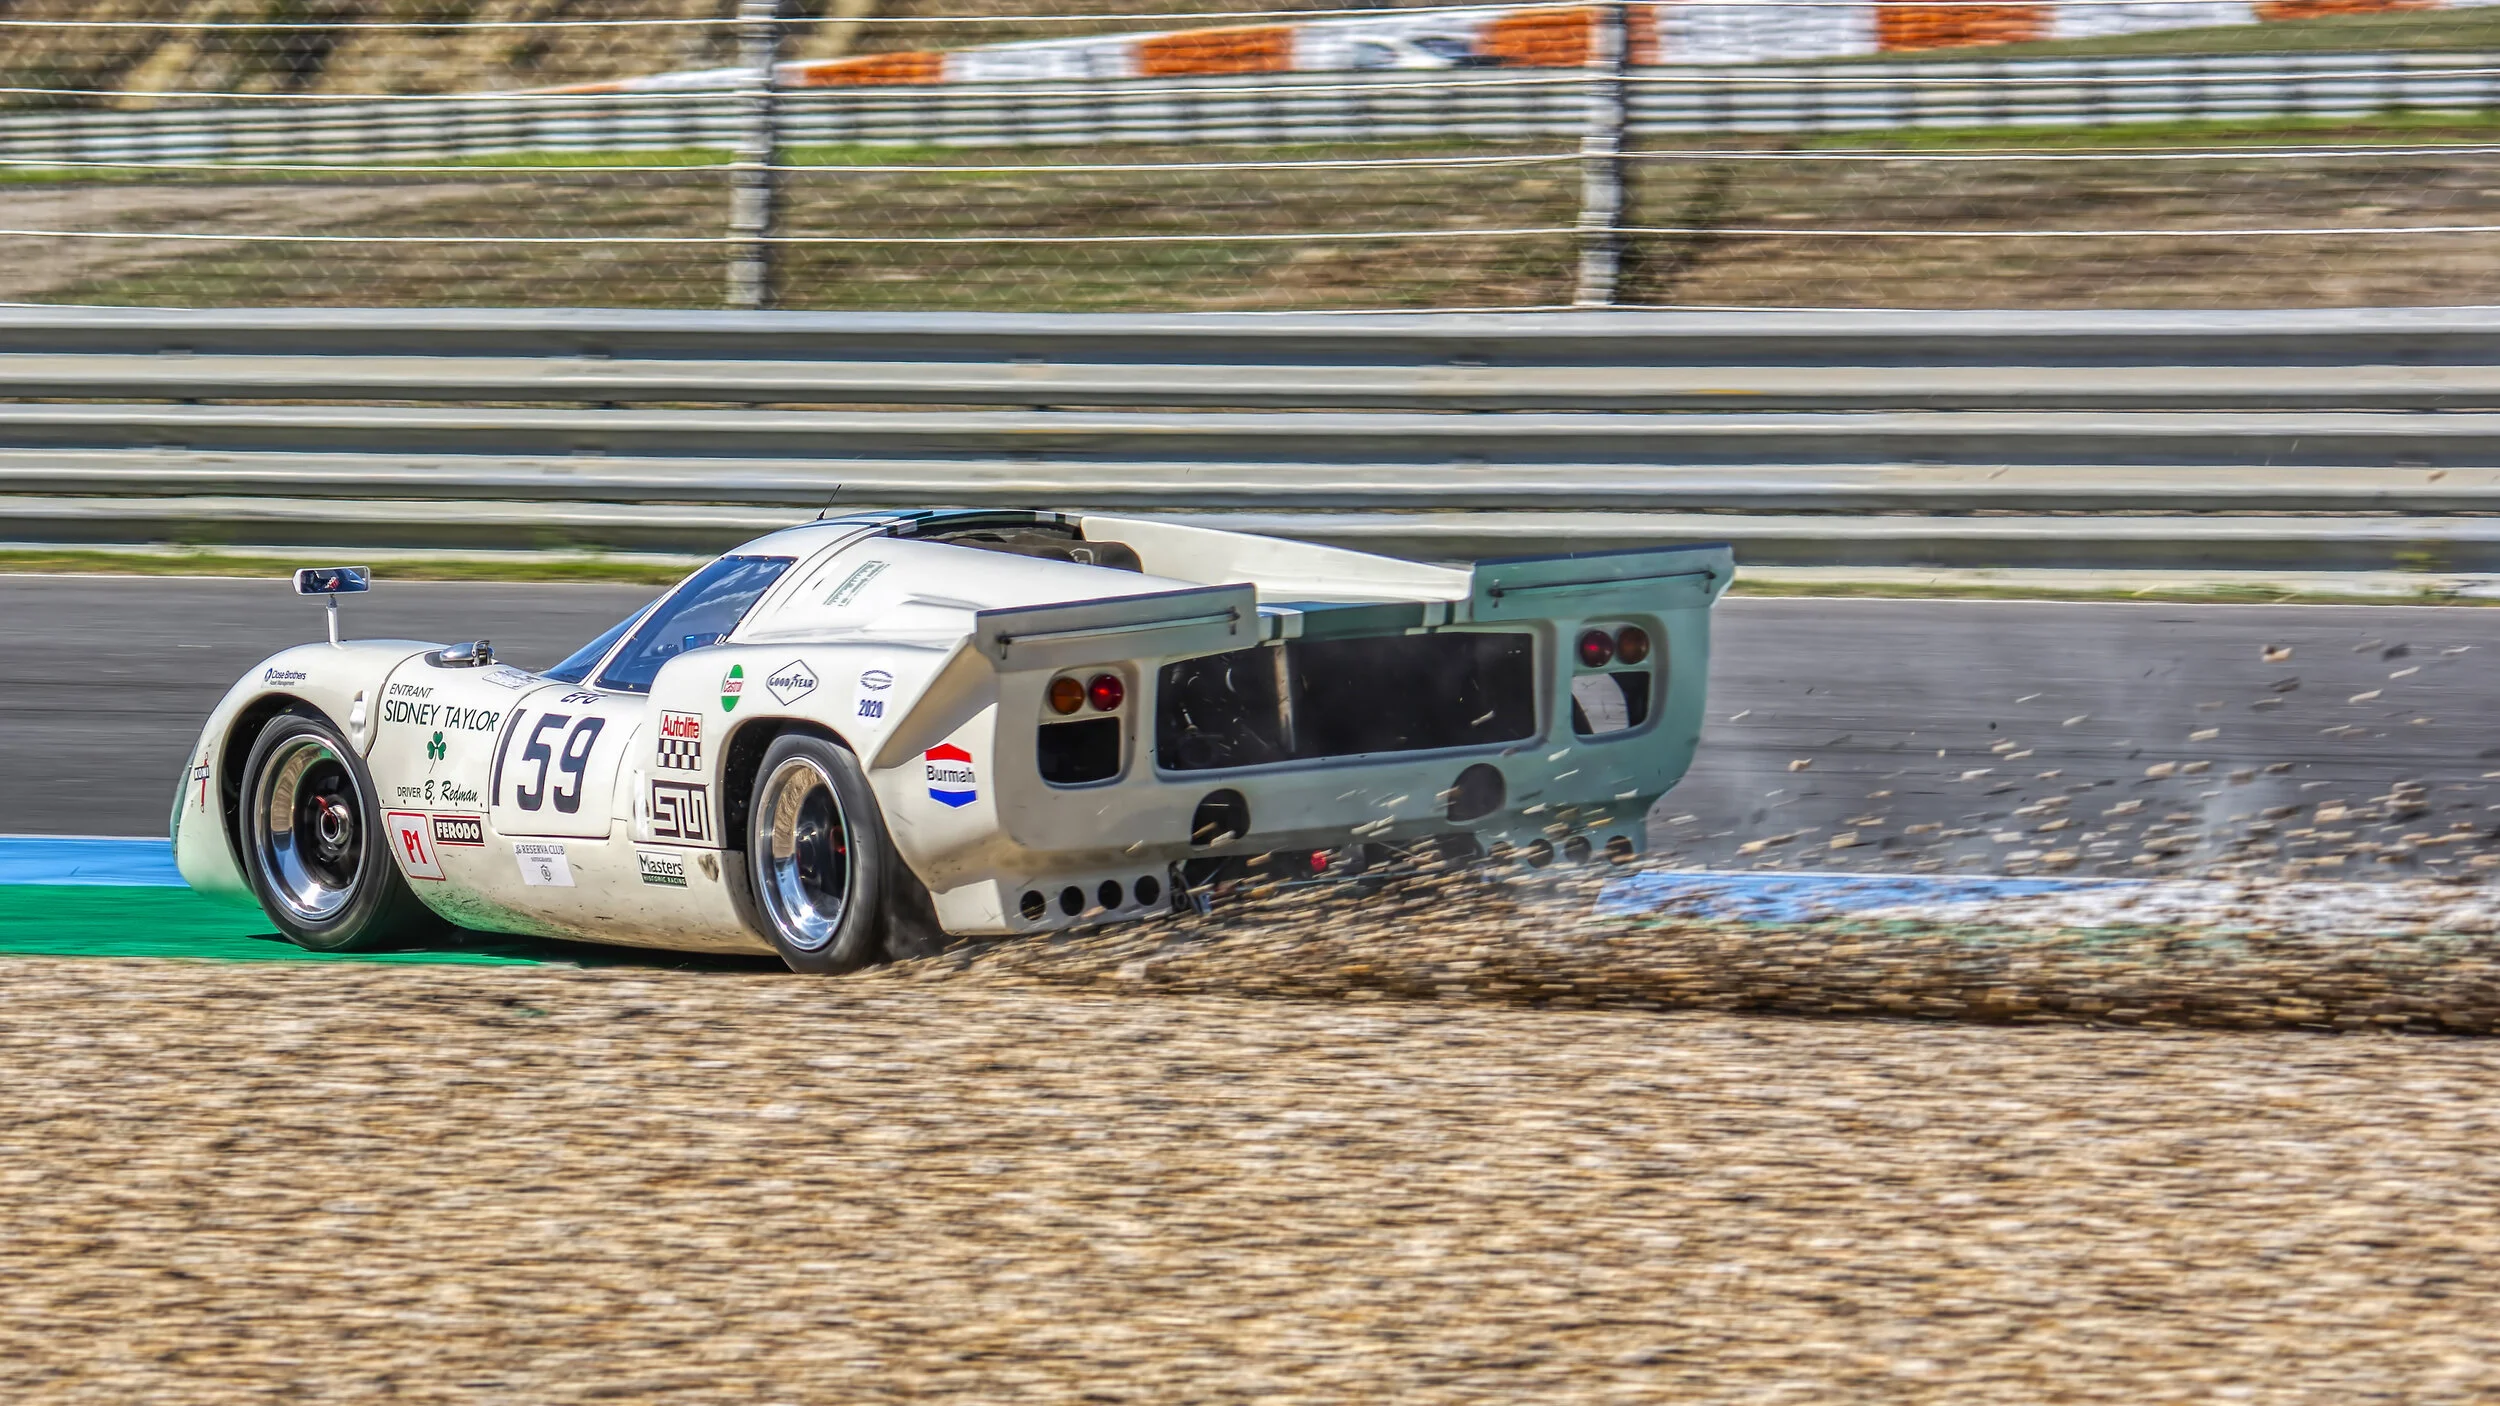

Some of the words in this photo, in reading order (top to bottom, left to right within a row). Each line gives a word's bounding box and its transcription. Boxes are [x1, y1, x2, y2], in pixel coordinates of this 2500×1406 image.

[389, 683, 433, 698] ENTRANT
[384, 699, 441, 726] SIDNEY
[444, 706, 500, 732] TAYLOR
[858, 699, 883, 718] 2020
[661, 714, 700, 738] Autolite
[492, 708, 606, 814] 159
[926, 765, 976, 783] Burmah
[397, 786, 421, 798] DRIVER
[424, 780, 435, 800] B.
[440, 780, 478, 803] Redman
[435, 821, 480, 840] FERODO
[401, 829, 427, 864] P1
[521, 844, 549, 855] RESERVA
[549, 845, 565, 855] CLUB
[638, 854, 683, 875] Masters
